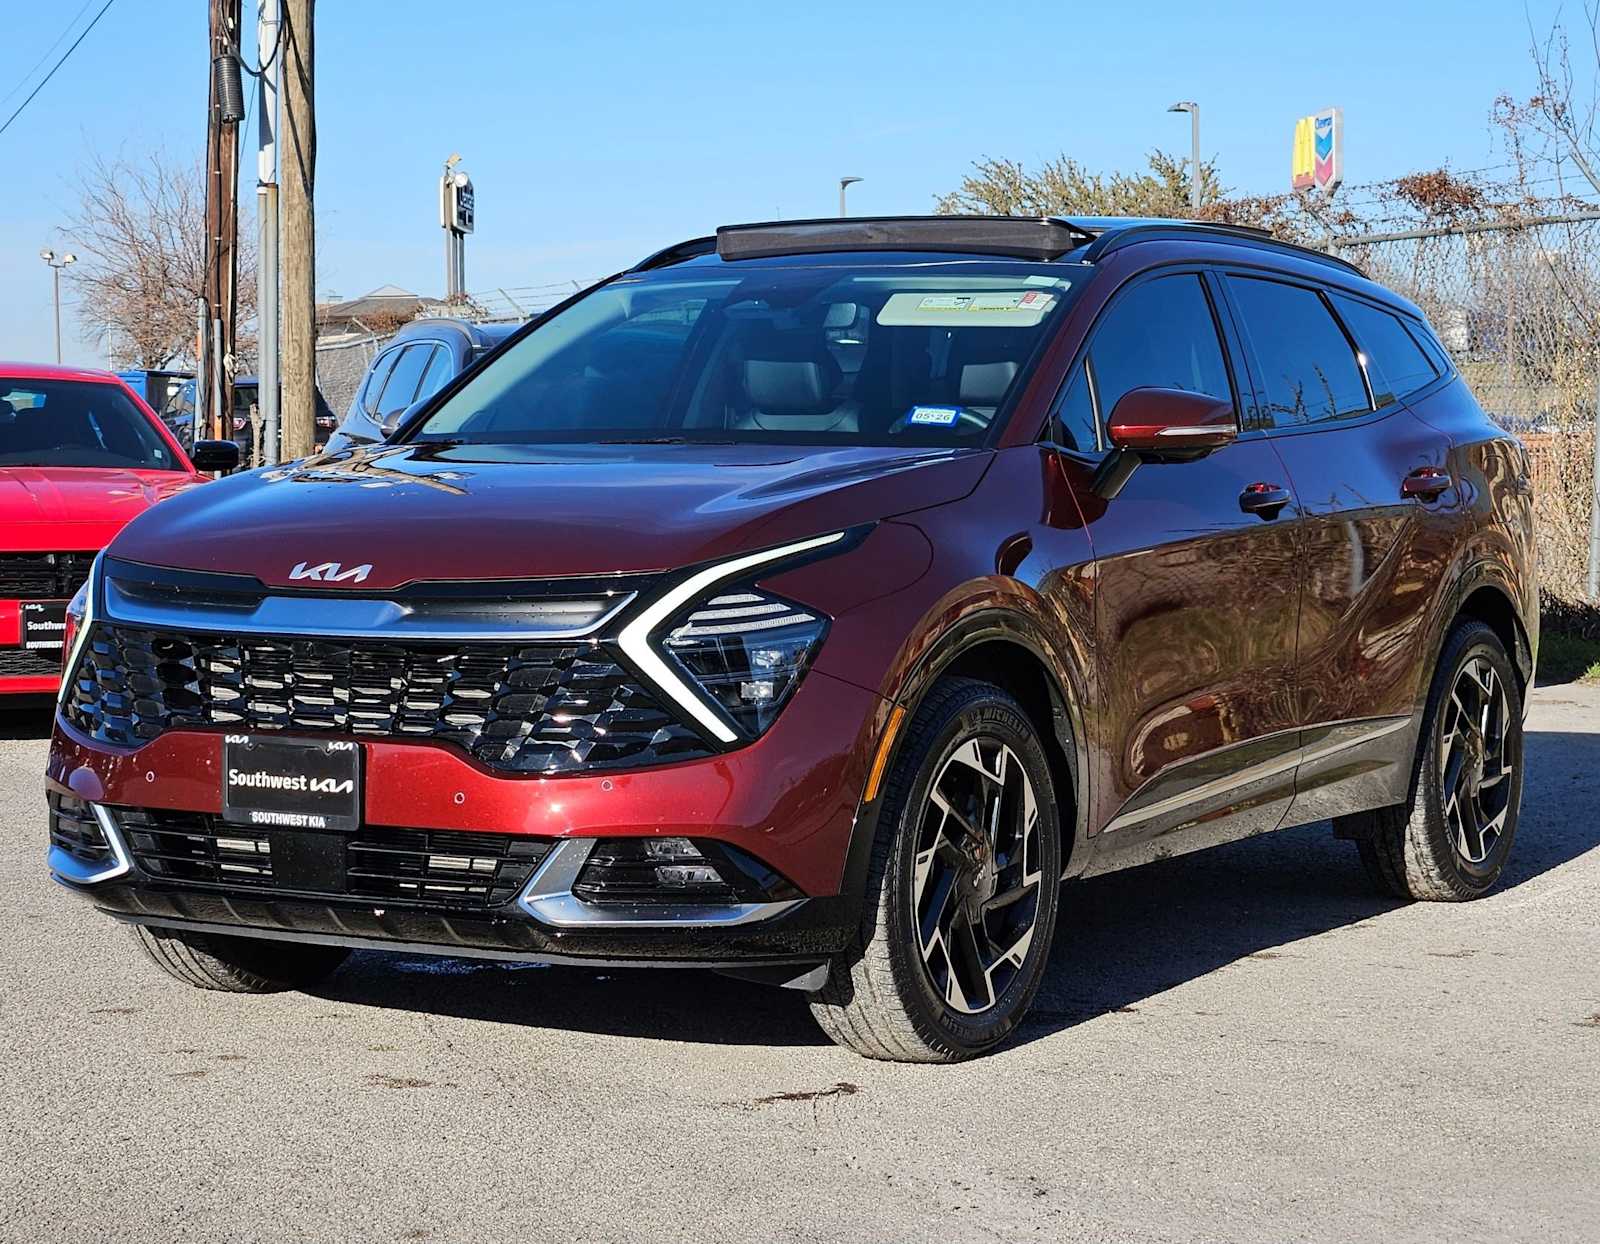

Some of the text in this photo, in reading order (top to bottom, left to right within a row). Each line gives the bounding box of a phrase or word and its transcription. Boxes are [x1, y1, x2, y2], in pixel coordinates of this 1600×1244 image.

[288, 561, 373, 583] KIA
[225, 735, 249, 744] KIA
[328, 741, 353, 751] KIA
[229, 769, 354, 794] Southwest KIA
[251, 811, 326, 828] SOUTHWEST KIA
